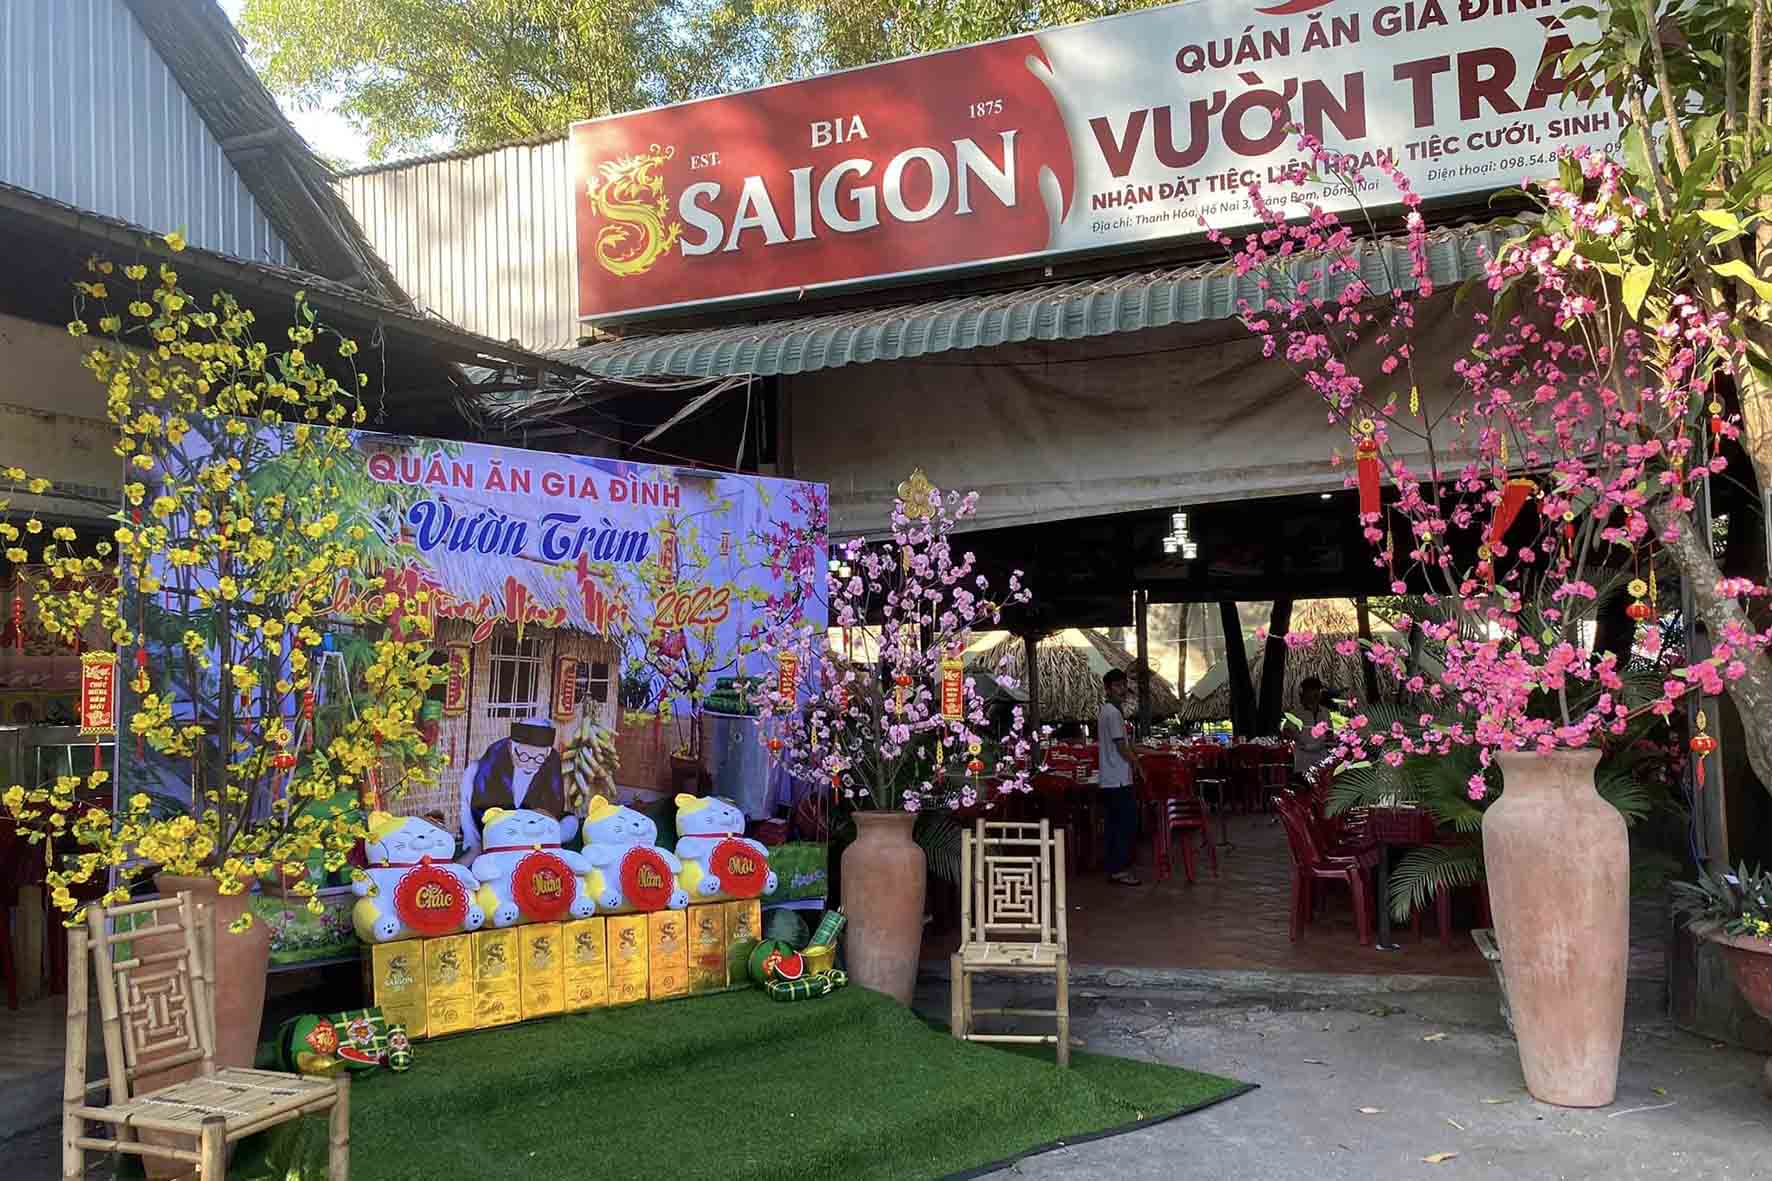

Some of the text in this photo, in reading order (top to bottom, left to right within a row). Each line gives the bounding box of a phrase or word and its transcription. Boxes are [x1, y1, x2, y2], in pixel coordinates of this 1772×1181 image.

[1175, 25, 1289, 74] QUÁN
[1301, 11, 1360, 53] ĂN
[1372, 0, 1448, 37] GIA
[968, 99, 1003, 121] 1875
[1088, 15, 1617, 178] VƯỜN TRÀ
[809, 114, 869, 149] BIA
[690, 151, 721, 170] EST.
[1092, 184, 1153, 210] NHẬN
[1158, 176, 1200, 202] ĐẶT
[1405, 134, 1460, 161] TIỆC
[1467, 121, 1541, 151] CƯỚI,
[1548, 112, 1609, 138] SINH
[1428, 169, 1456, 181] Điện
[1459, 161, 1497, 176] thoại:
[679, 129, 1020, 258] SAIGON
[1092, 221, 1110, 233] Địa
[1136, 213, 1170, 225] Thanh
[1220, 200, 1239, 213] Nai
[1359, 179, 1379, 192] Nai
[369, 451, 680, 508] QUÁN ĂN GIA ĐÌNH
[408, 500, 528, 555] Vườn
[540, 512, 650, 562] Tràm
[655, 587, 731, 629] 2023
